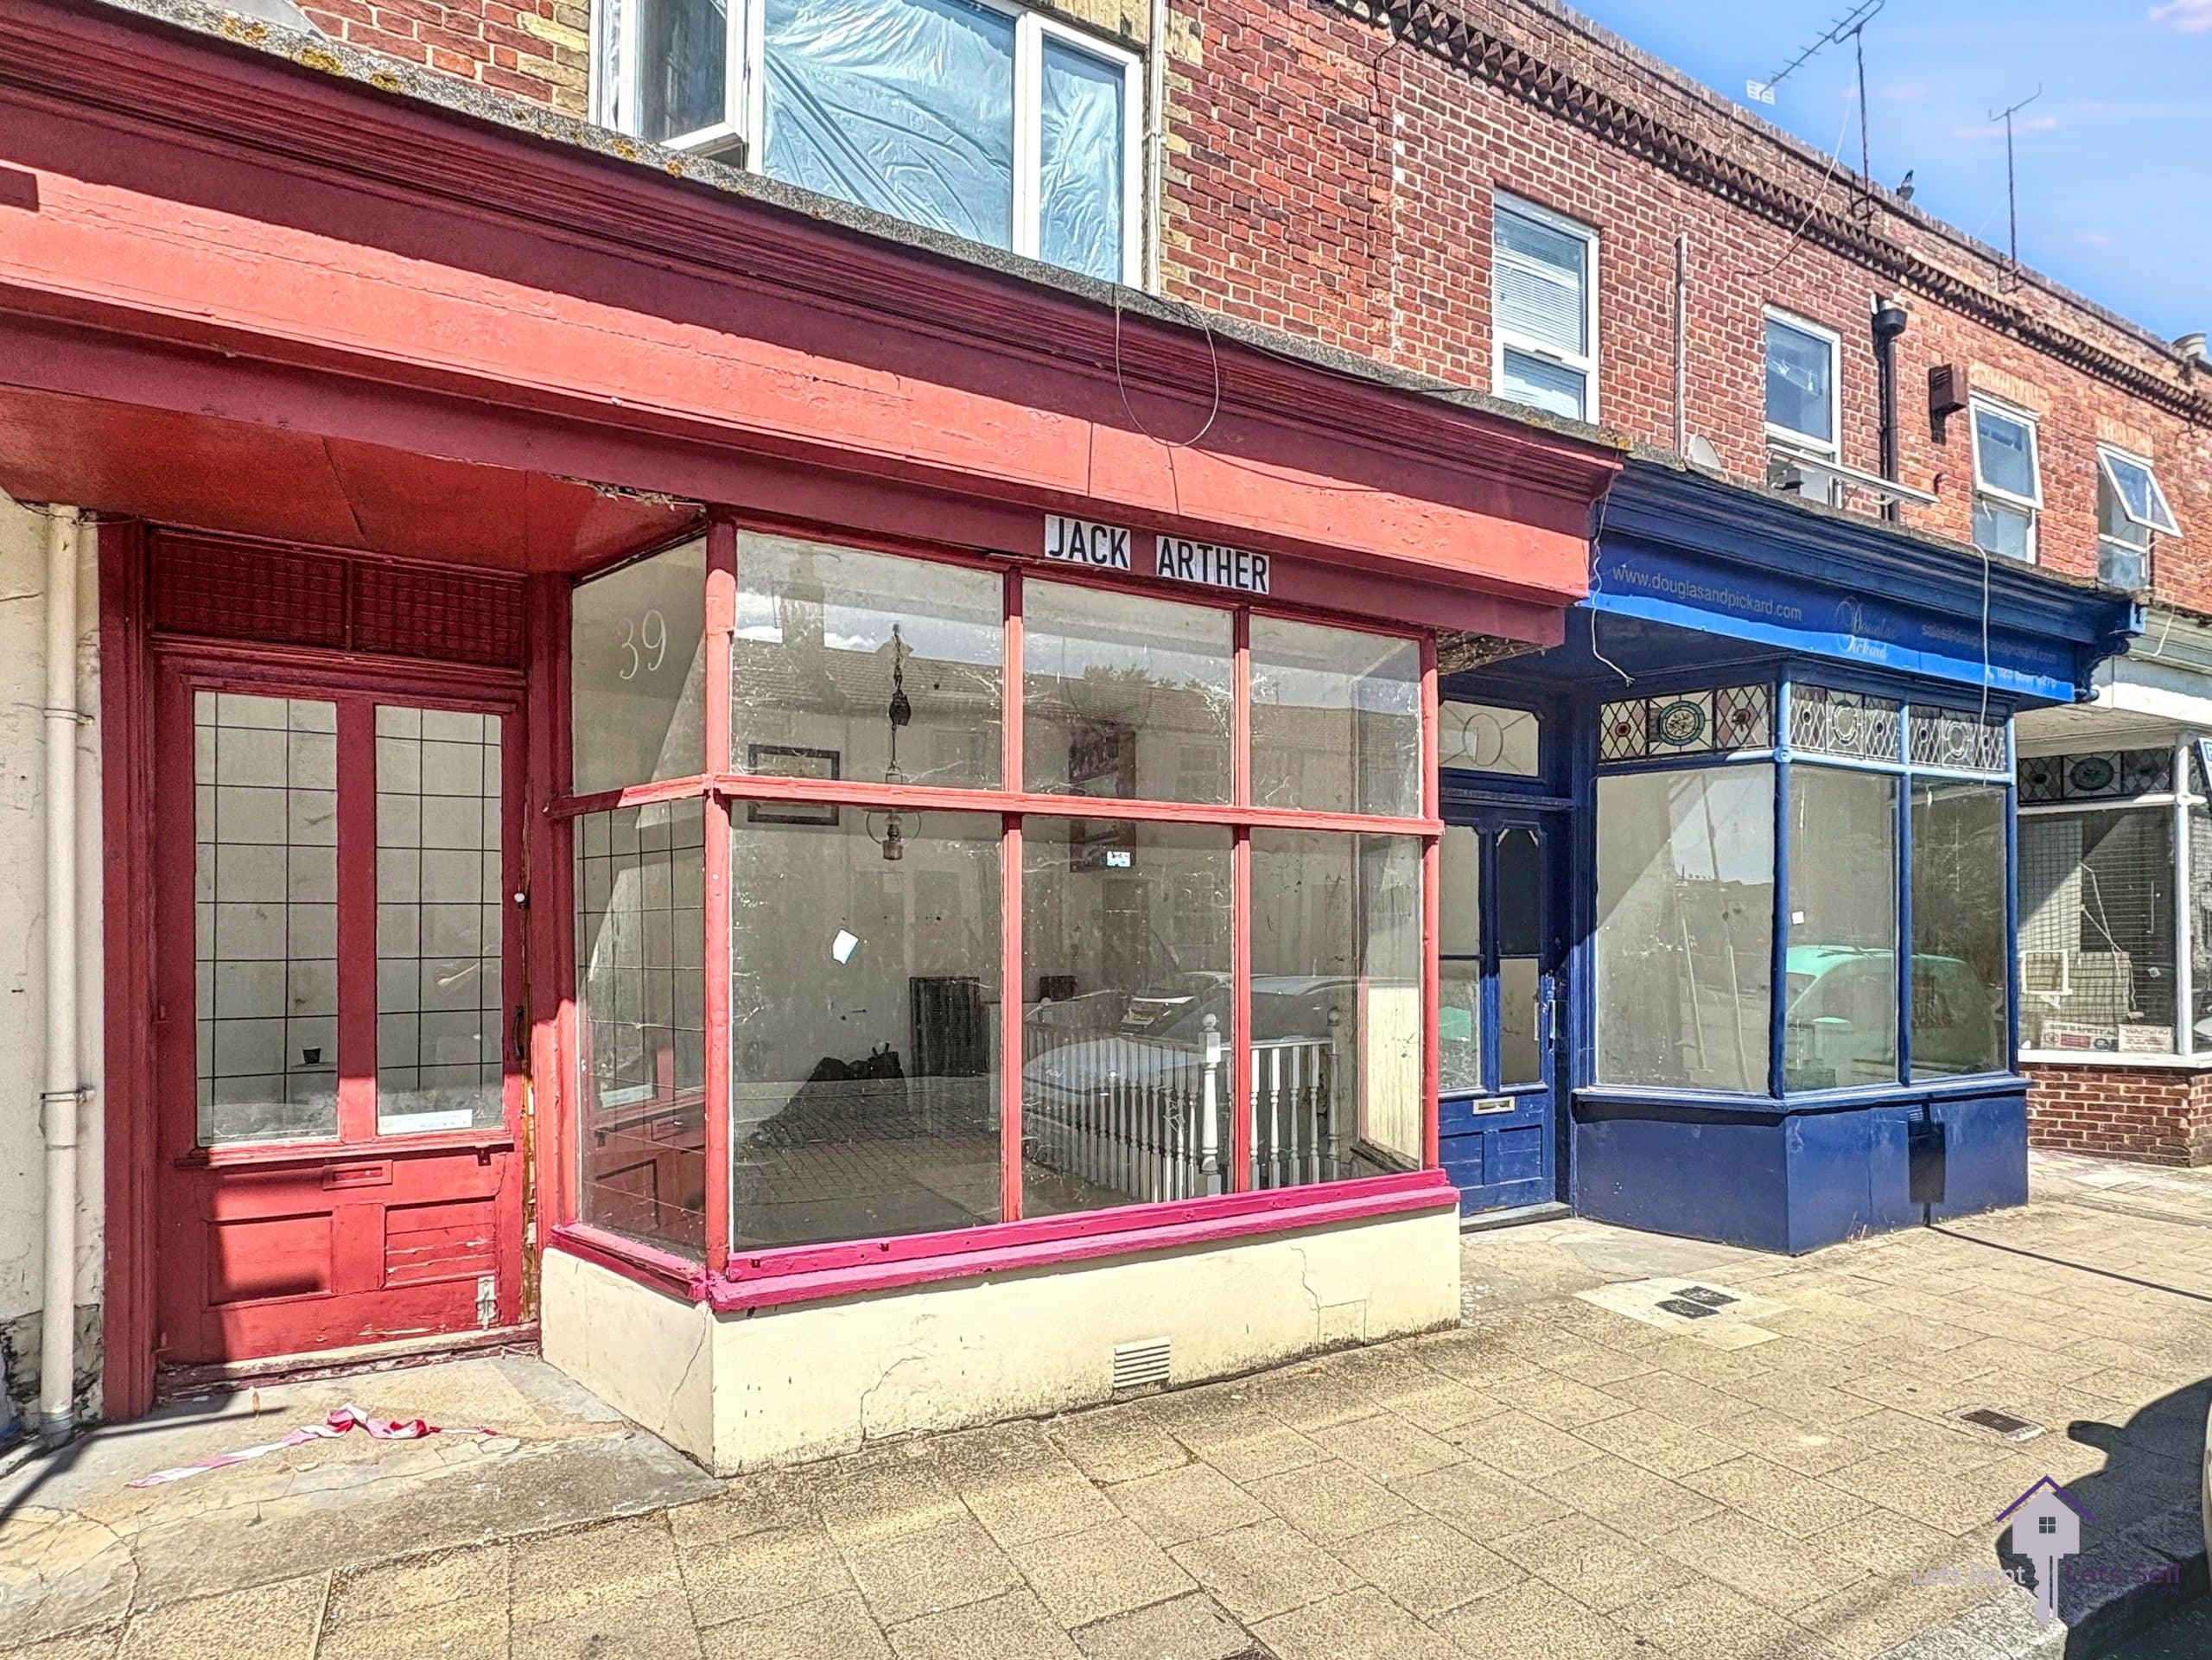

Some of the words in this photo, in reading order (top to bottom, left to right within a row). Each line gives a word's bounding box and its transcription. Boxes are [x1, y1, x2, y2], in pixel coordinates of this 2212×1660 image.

[1048, 518, 1128, 569] JACK
[1158, 537, 1267, 592] ARTHER
[1612, 566, 1802, 621] www.douglasandpickard.com
[617, 608, 666, 680] 39
